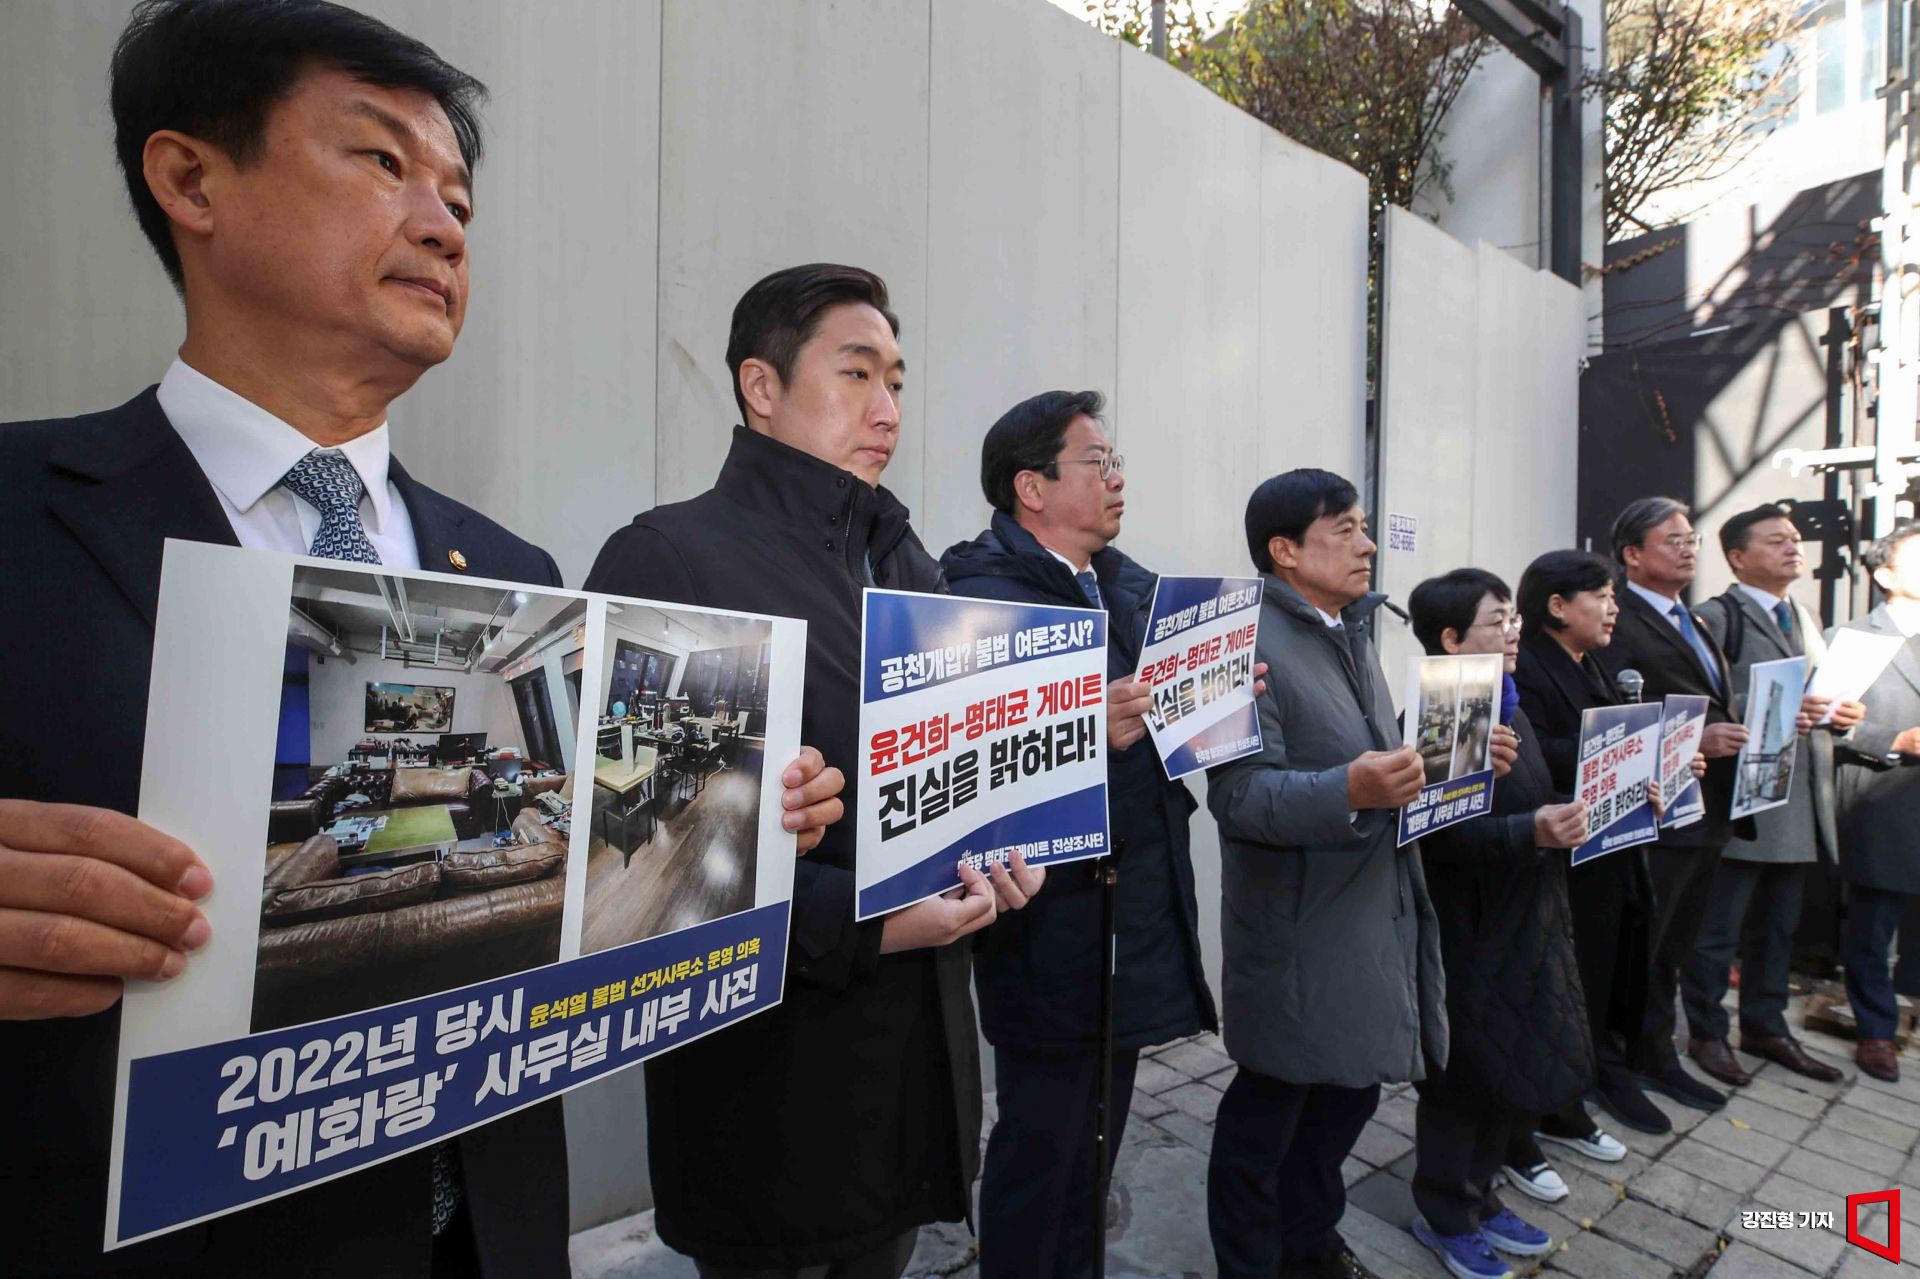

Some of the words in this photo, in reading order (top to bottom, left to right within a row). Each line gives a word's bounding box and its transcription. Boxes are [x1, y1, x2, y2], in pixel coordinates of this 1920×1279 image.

[1154, 605, 1198, 641] 공천개입?
[1198, 597, 1218, 622] 불법
[1218, 585, 1257, 614] 여론조사?
[1224, 623, 1256, 655] 게이트
[881, 641, 972, 694] 공천개입?
[976, 633, 1010, 669] 불법
[1014, 619, 1094, 658] 여론조사?
[1201, 652, 1250, 706] 밝혀라!
[870, 688, 1029, 776] 윤건희-명태균
[1036, 673, 1102, 718] 게이트
[878, 749, 979, 842] 진실을
[990, 714, 1096, 791] 밝혀라!
[1429, 787, 1444, 806] 당시
[1432, 801, 1455, 825] 사무실
[1454, 796, 1470, 817] 내부
[1469, 792, 1485, 812] 사진
[1052, 832, 1104, 855] 진상조사단
[529, 991, 588, 1030] 윤석열
[592, 979, 627, 1010] 불법
[630, 957, 705, 997] 선거사무소
[707, 945, 734, 970] 운영
[736, 937, 761, 962] 의혹
[216, 1015, 418, 1115] 2022년
[434, 987, 525, 1056] 당시
[474, 1014, 612, 1107] 사무실
[620, 987, 692, 1052] 내부
[699, 962, 760, 1022] 사진
